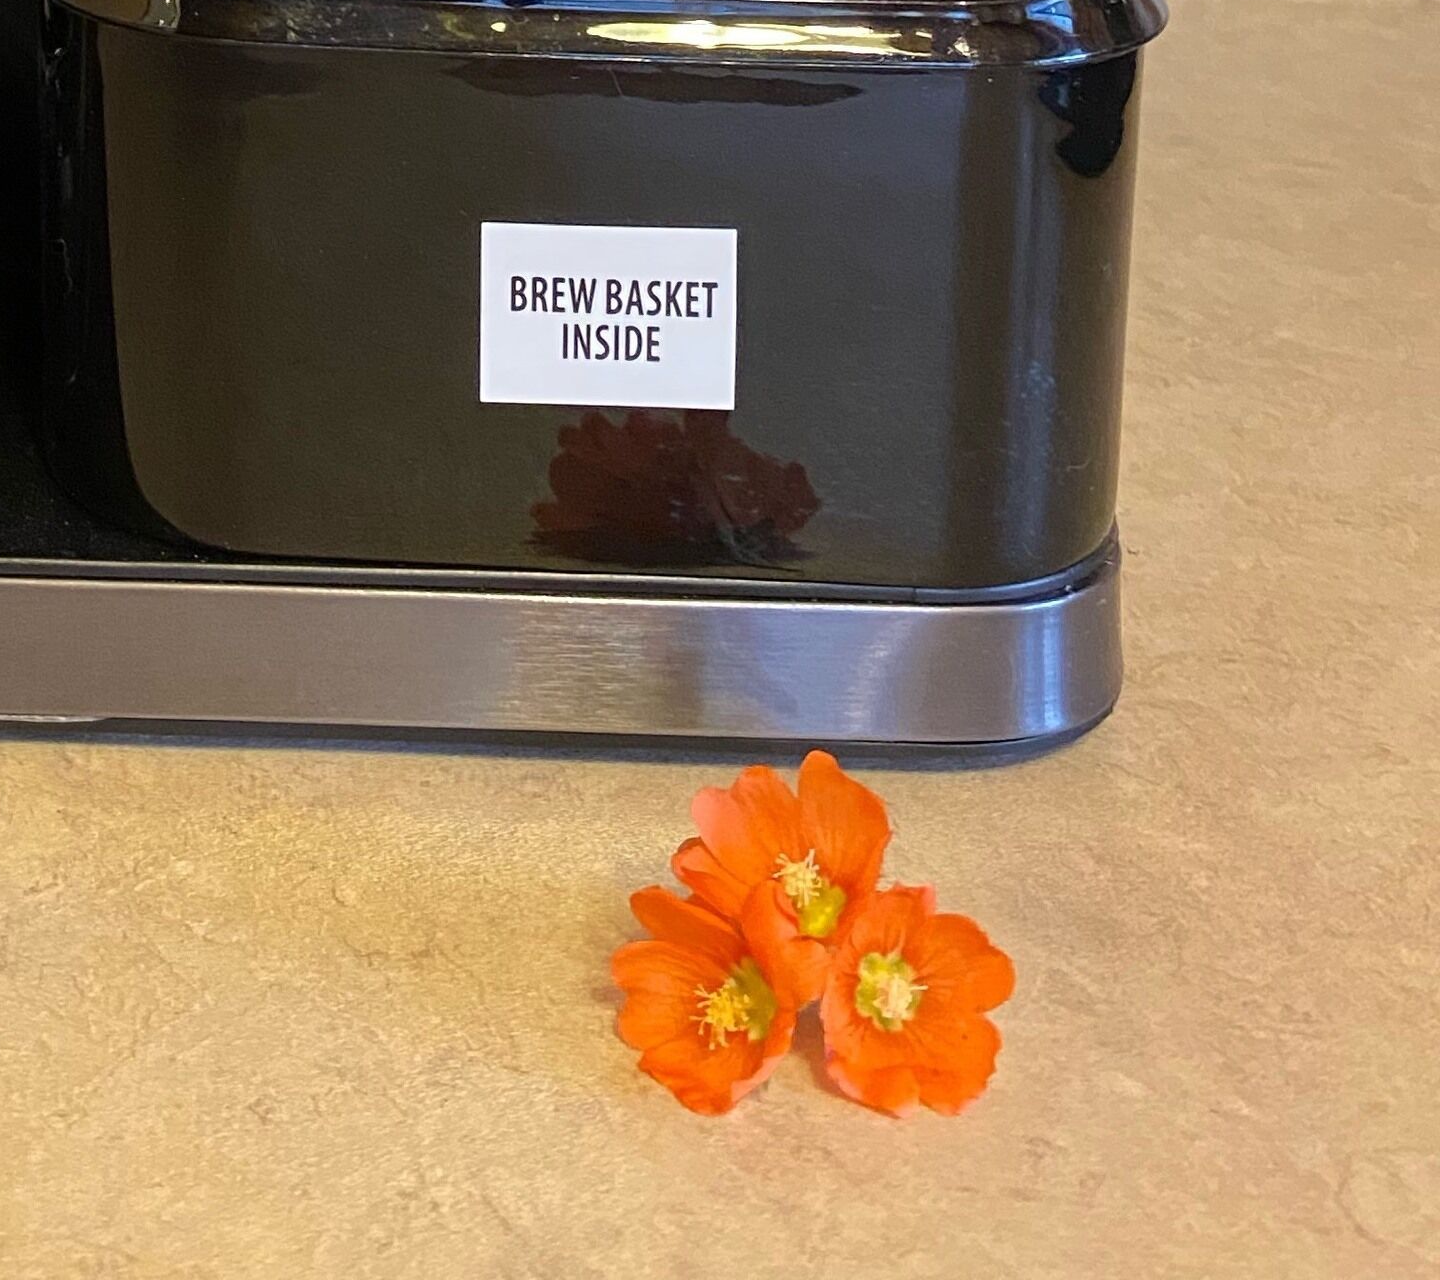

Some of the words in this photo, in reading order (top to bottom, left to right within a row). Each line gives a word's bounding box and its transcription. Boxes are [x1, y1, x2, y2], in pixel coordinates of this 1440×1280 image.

[509, 275, 597, 315] BREW
[605, 278, 719, 318] BASKET
[561, 322, 661, 362] INSIDE
